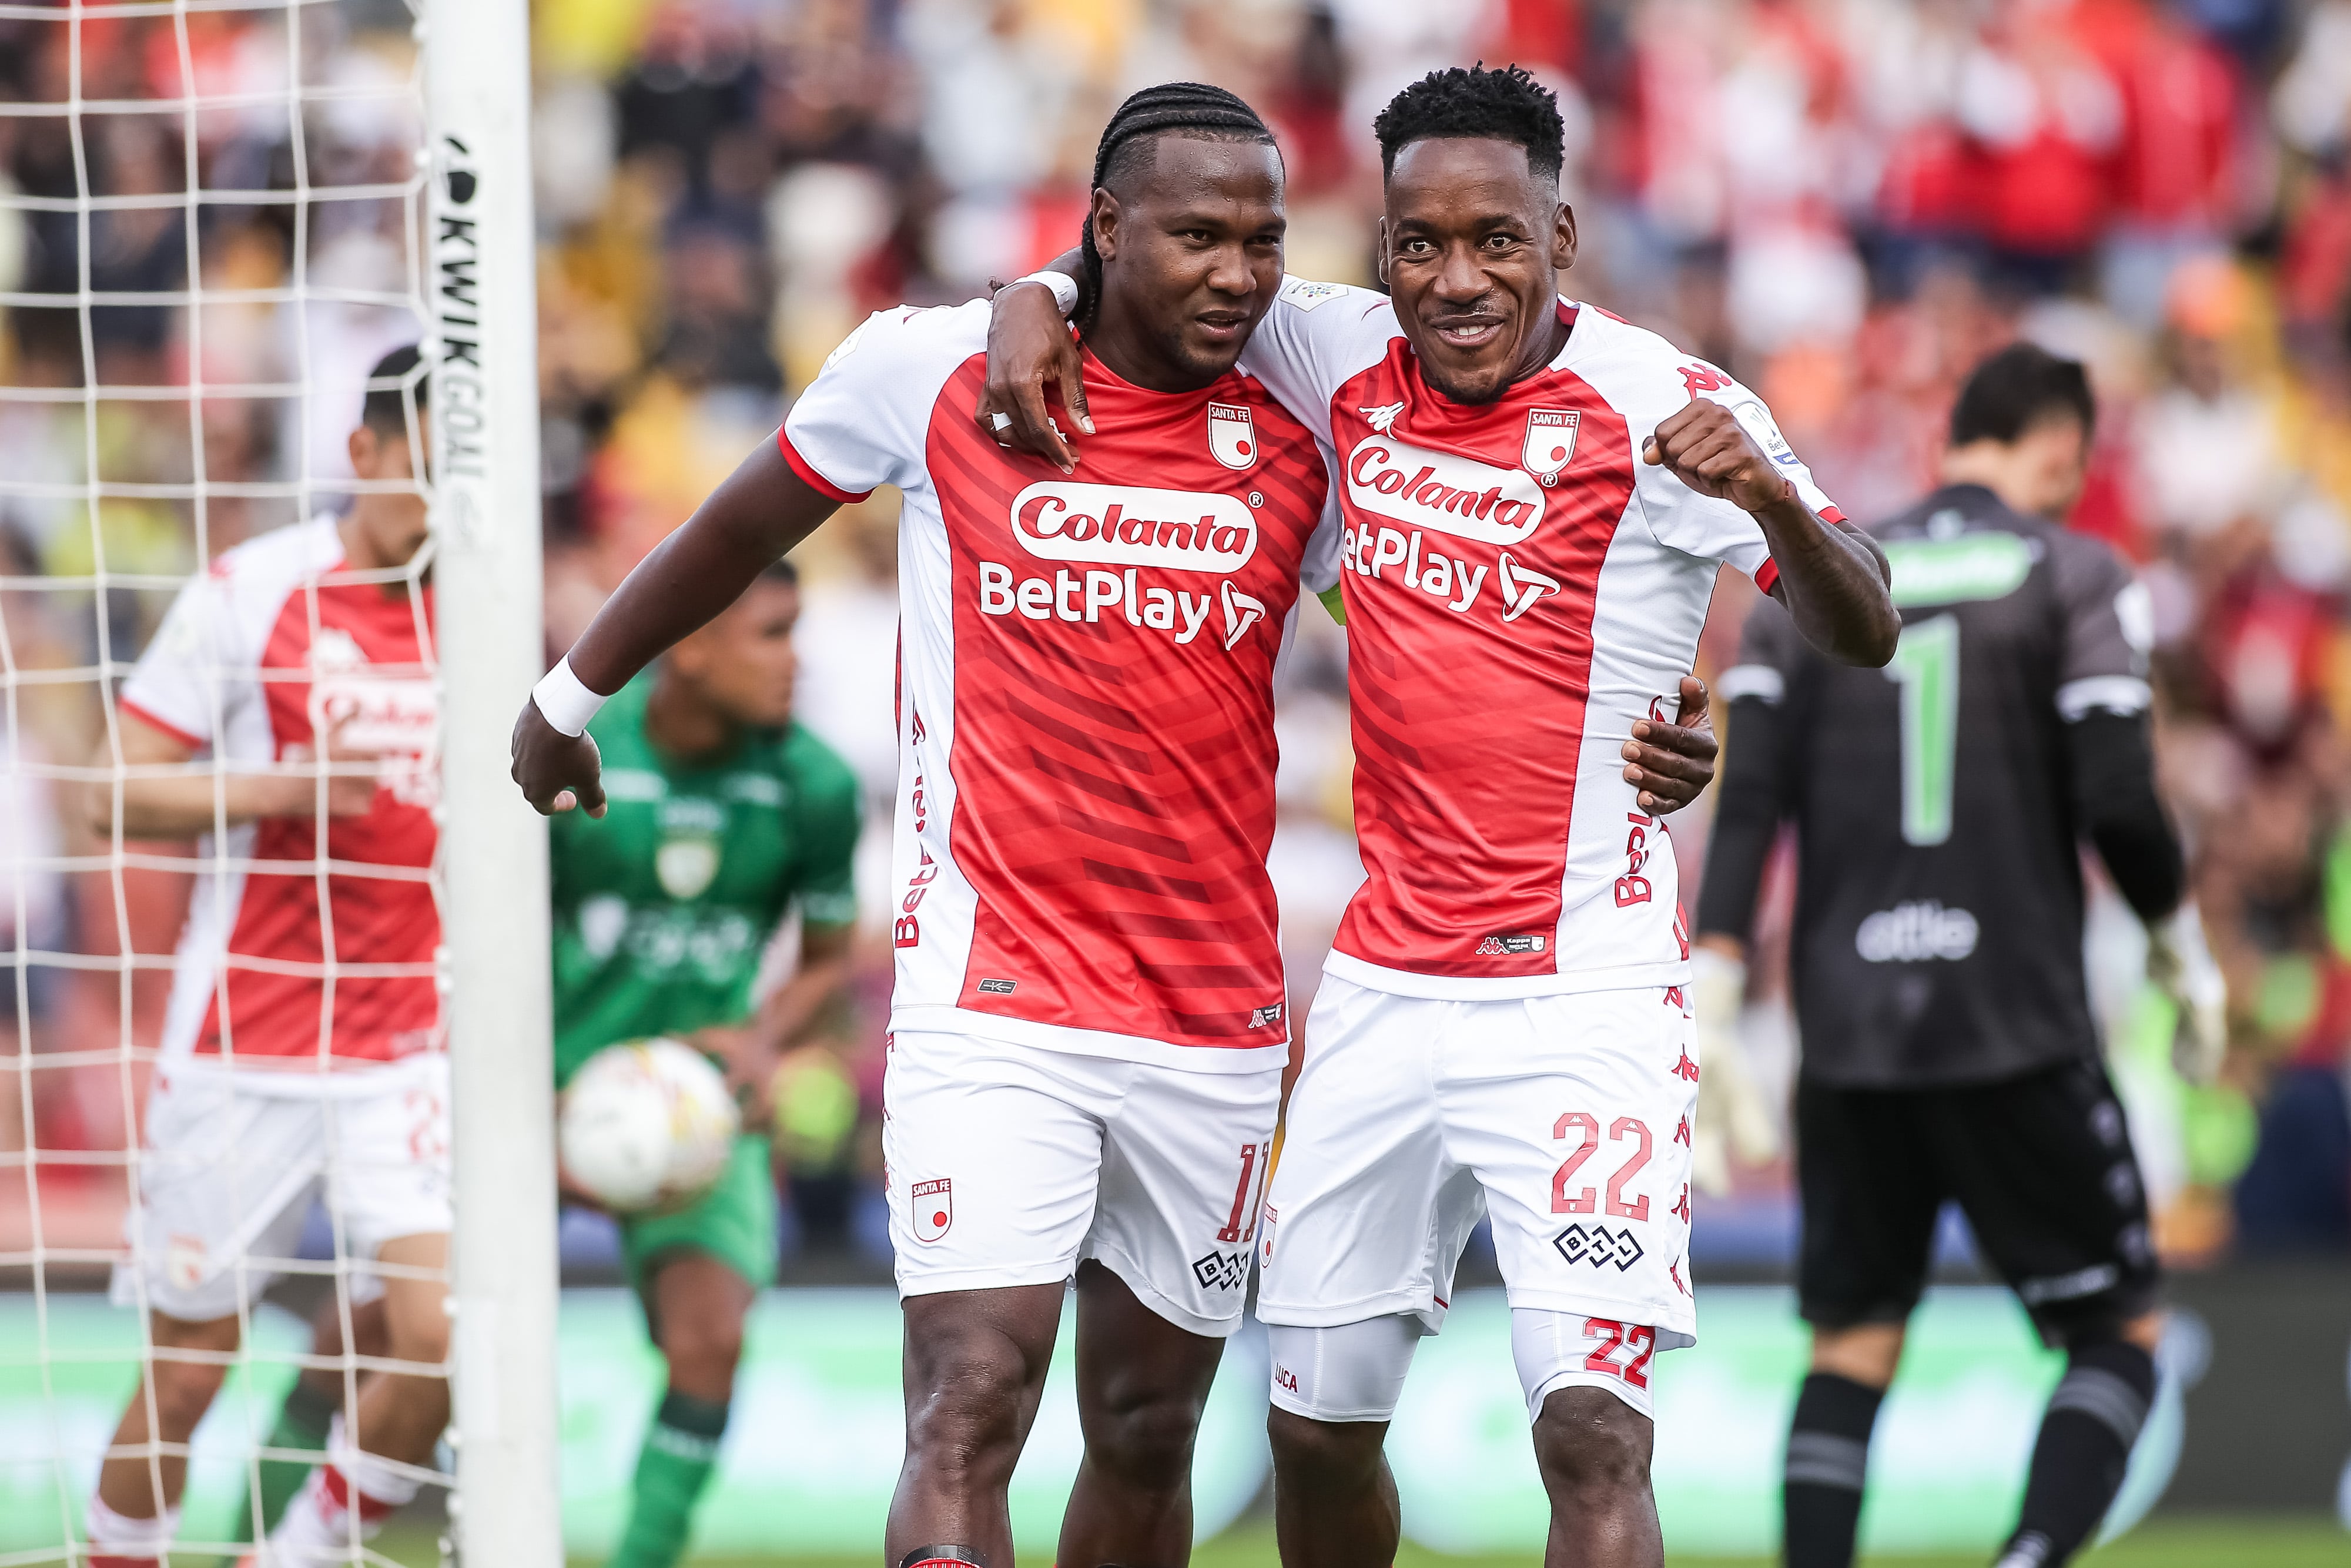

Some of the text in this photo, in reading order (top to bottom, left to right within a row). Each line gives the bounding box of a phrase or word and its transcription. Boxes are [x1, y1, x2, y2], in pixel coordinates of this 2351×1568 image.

[1211, 407, 1248, 421] SANTA FE
[1532, 413, 1576, 426] SANTA FE
[1019, 495, 1250, 555] Colanta
[1351, 446, 1537, 528] Colanta
[1341, 512, 1490, 613] etPlay
[979, 561, 1212, 645] BetPlay
[1884, 613, 1959, 847] 1
[913, 1180, 950, 1197] SANTA FE
[1217, 1142, 1270, 1243] 11
[1551, 1112, 1652, 1222] 22
[1275, 1362, 1298, 1393] LUCA
[1582, 1317, 1656, 1392] 22
